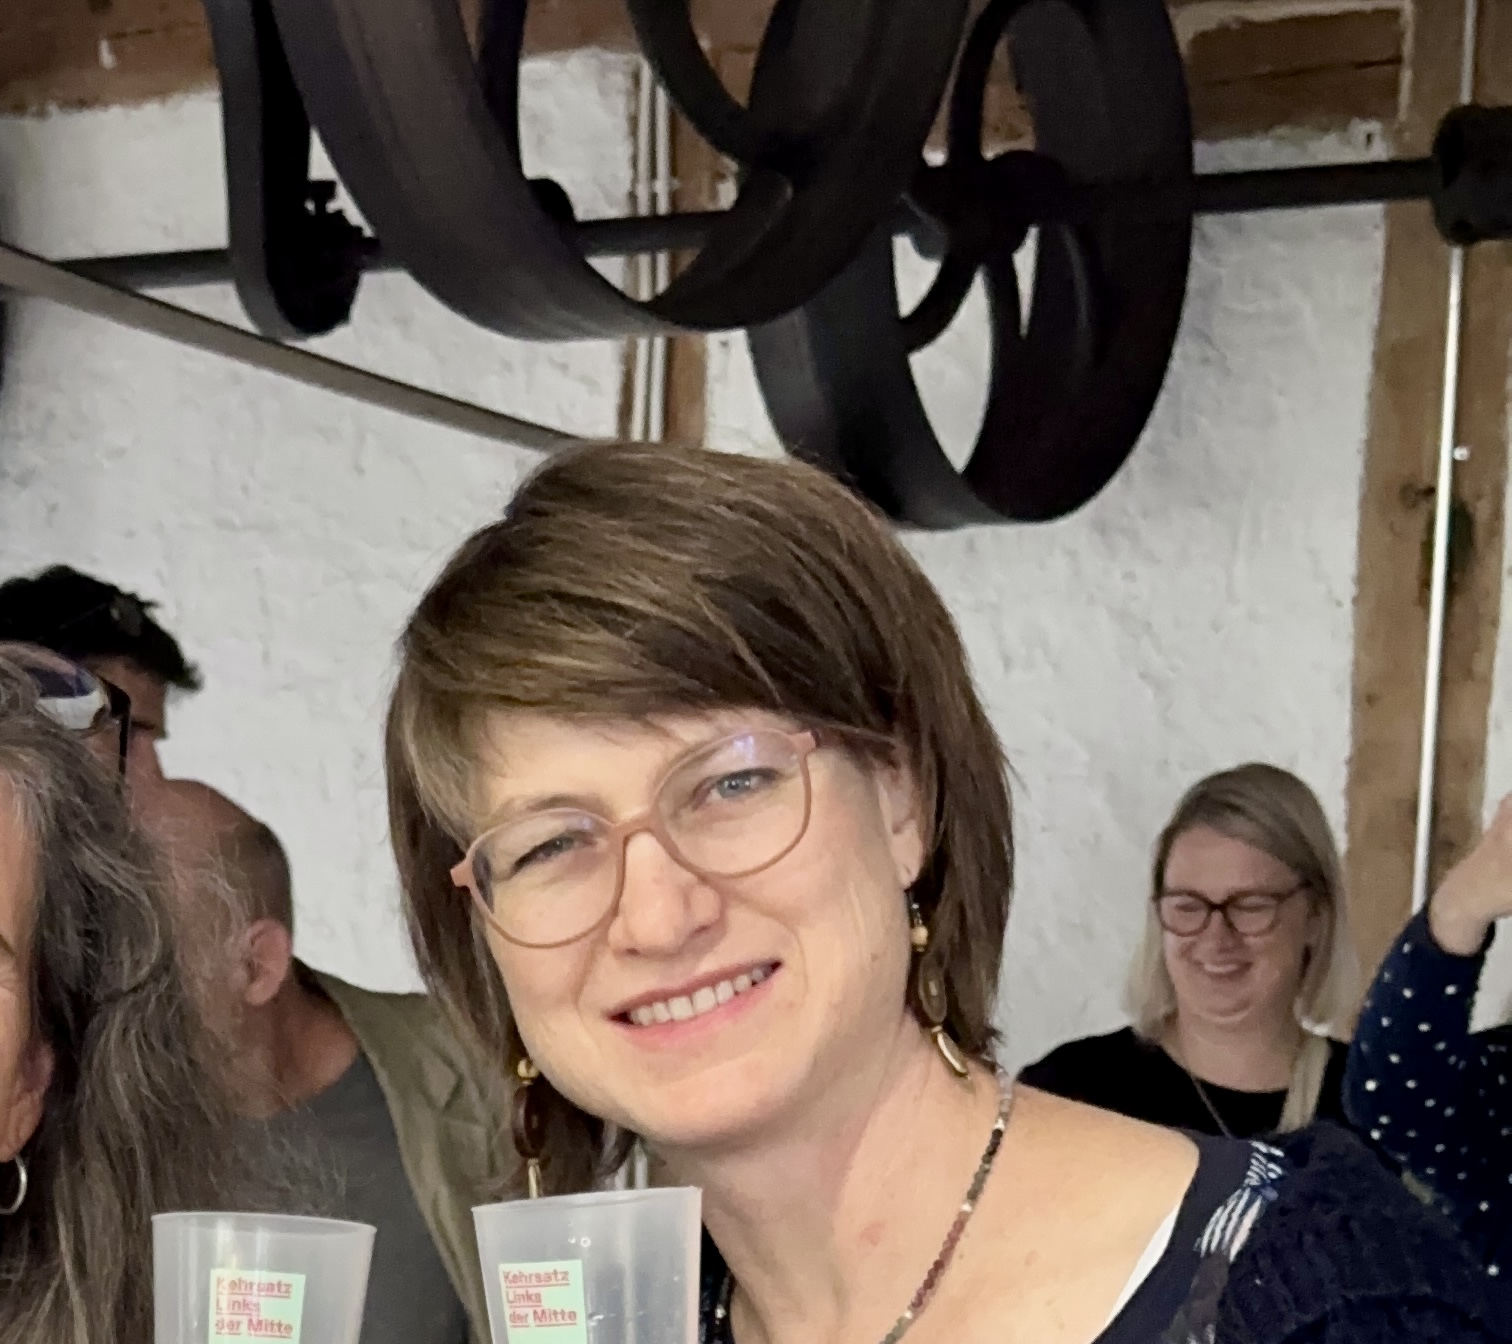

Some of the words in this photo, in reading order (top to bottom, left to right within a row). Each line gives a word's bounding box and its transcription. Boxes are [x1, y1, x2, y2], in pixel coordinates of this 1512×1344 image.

[502, 1268, 570, 1286] Kehrsatz
[506, 1289, 542, 1305] Links
[509, 1311, 530, 1324] der
[532, 1308, 578, 1323] Mitte
[215, 1317, 243, 1332] der
[247, 1317, 293, 1336] Mitte
